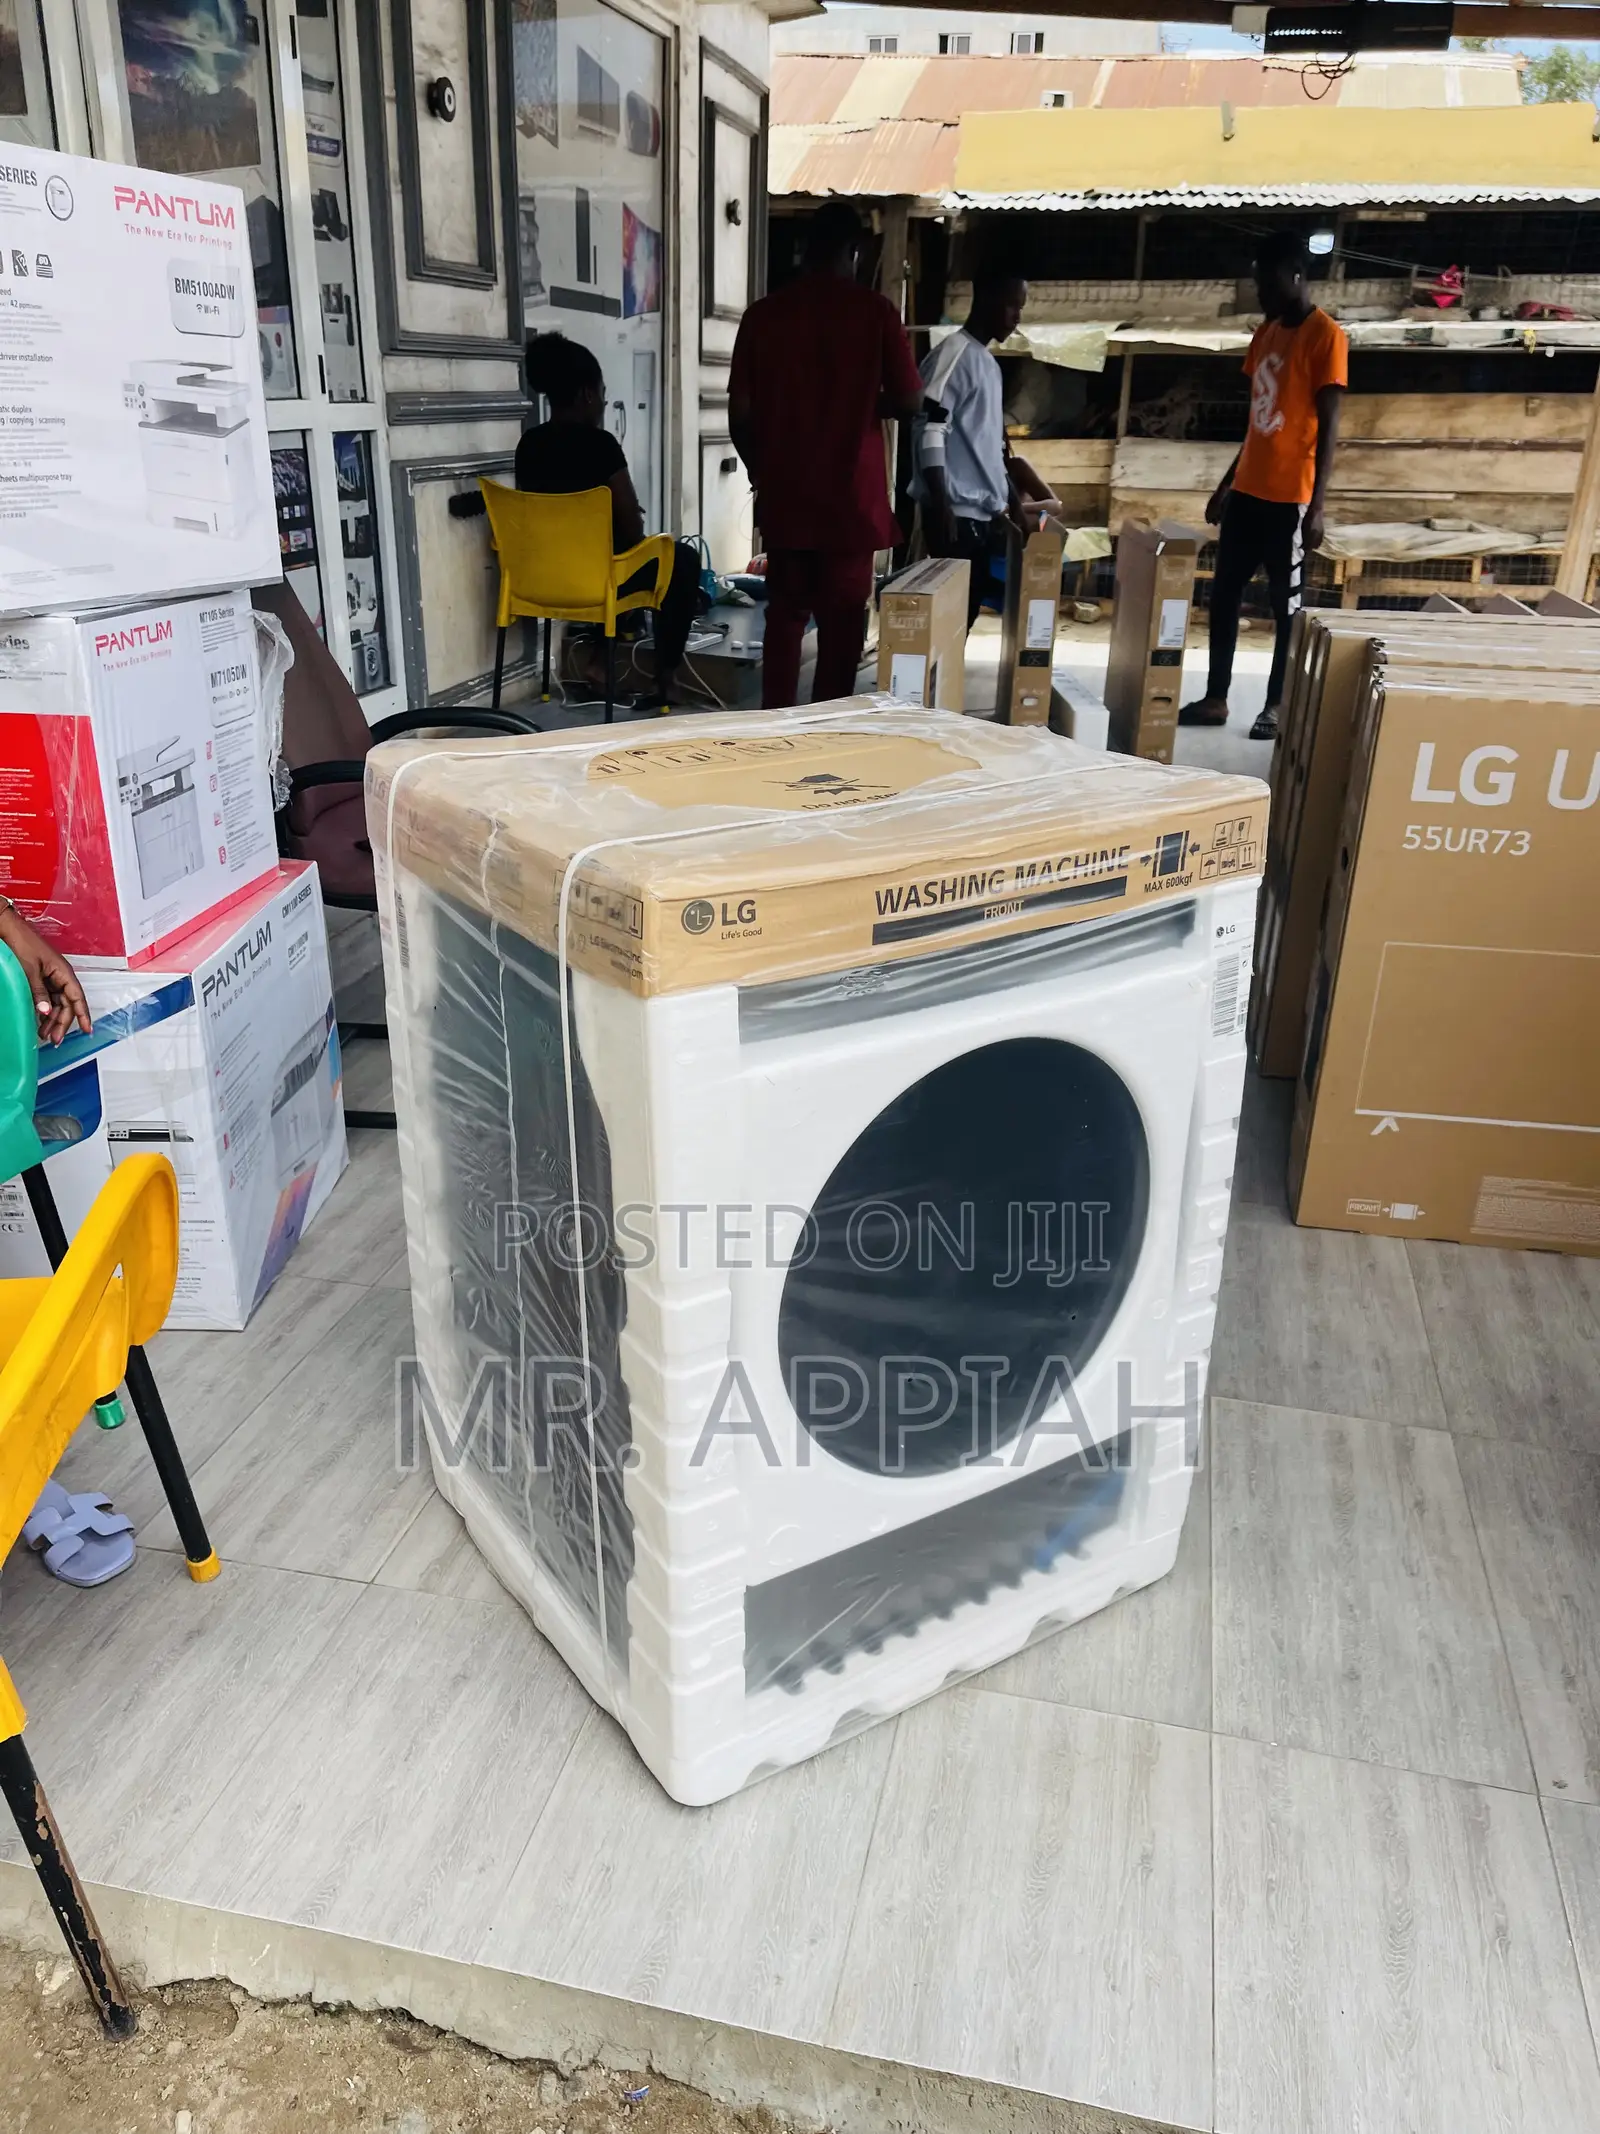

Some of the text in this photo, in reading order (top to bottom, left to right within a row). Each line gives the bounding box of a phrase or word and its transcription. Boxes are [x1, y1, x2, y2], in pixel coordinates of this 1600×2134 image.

[0, 165, 38, 187] SERIES
[114, 185, 235, 230] PANTUM
[124, 223, 233, 251] The New Era for Printing
[174, 277, 235, 300] BM5100ADW
[203, 304, 220, 316] Wi-Fi
[18, 353, 54, 363] installation
[11, 405, 33, 415] duplex
[9, 416, 34, 427] copying
[38, 417, 66, 426] scanning
[19, 472, 60, 483] multipurpose
[60, 473, 72, 482] tray
[95, 619, 173, 657] PANTUM
[210, 663, 248, 689] M7105DW
[1410, 741, 1520, 807] LG
[1402, 823, 1533, 857] 55UR73
[875, 845, 1131, 916] WASHING MACHINE
[1144, 871, 1194, 893] MAX 600kgf
[721, 899, 757, 927] LG
[983, 900, 1025, 920] FRONT
[721, 927, 763, 940] Life's Good
[1225, 924, 1236, 935] LG
[201, 920, 272, 1008] PANTUM
